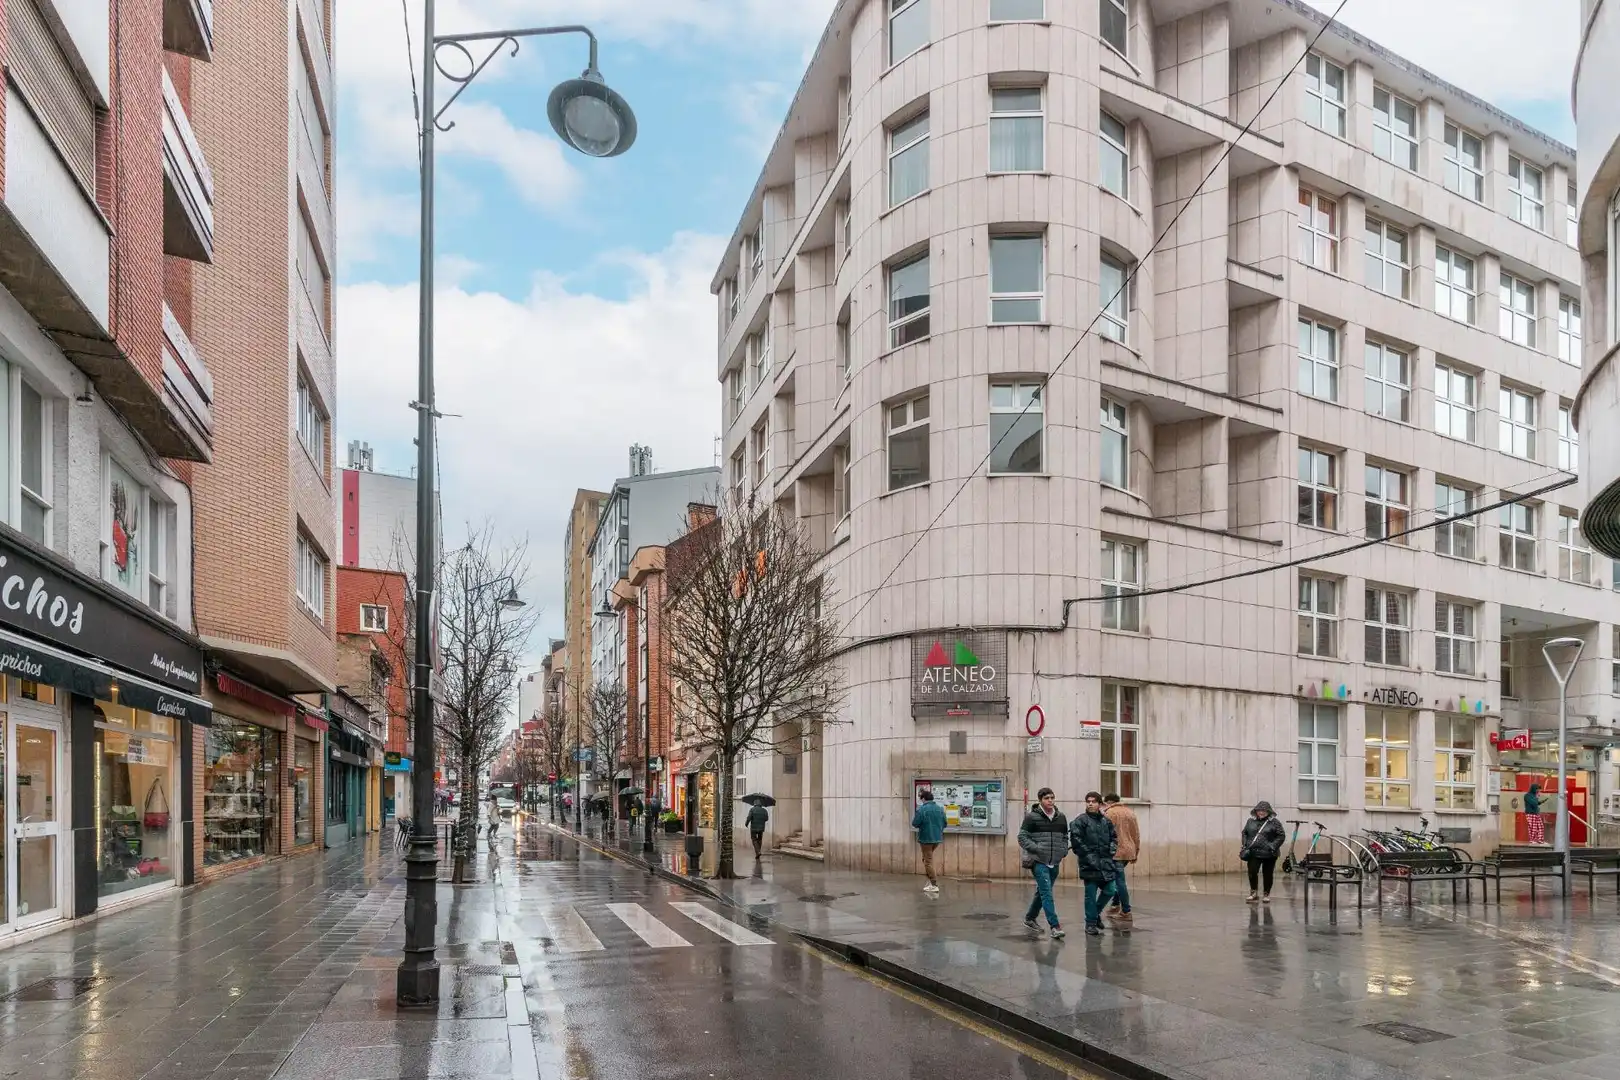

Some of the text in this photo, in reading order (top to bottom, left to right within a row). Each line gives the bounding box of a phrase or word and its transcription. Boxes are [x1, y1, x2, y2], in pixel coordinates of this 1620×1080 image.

[0, 556, 84, 634] chos
[0, 653, 43, 676] prichos
[922, 665, 996, 683] ATENEO
[921, 683, 995, 694] DE LA CALZADA
[1372, 687, 1419, 706] ATENEO
